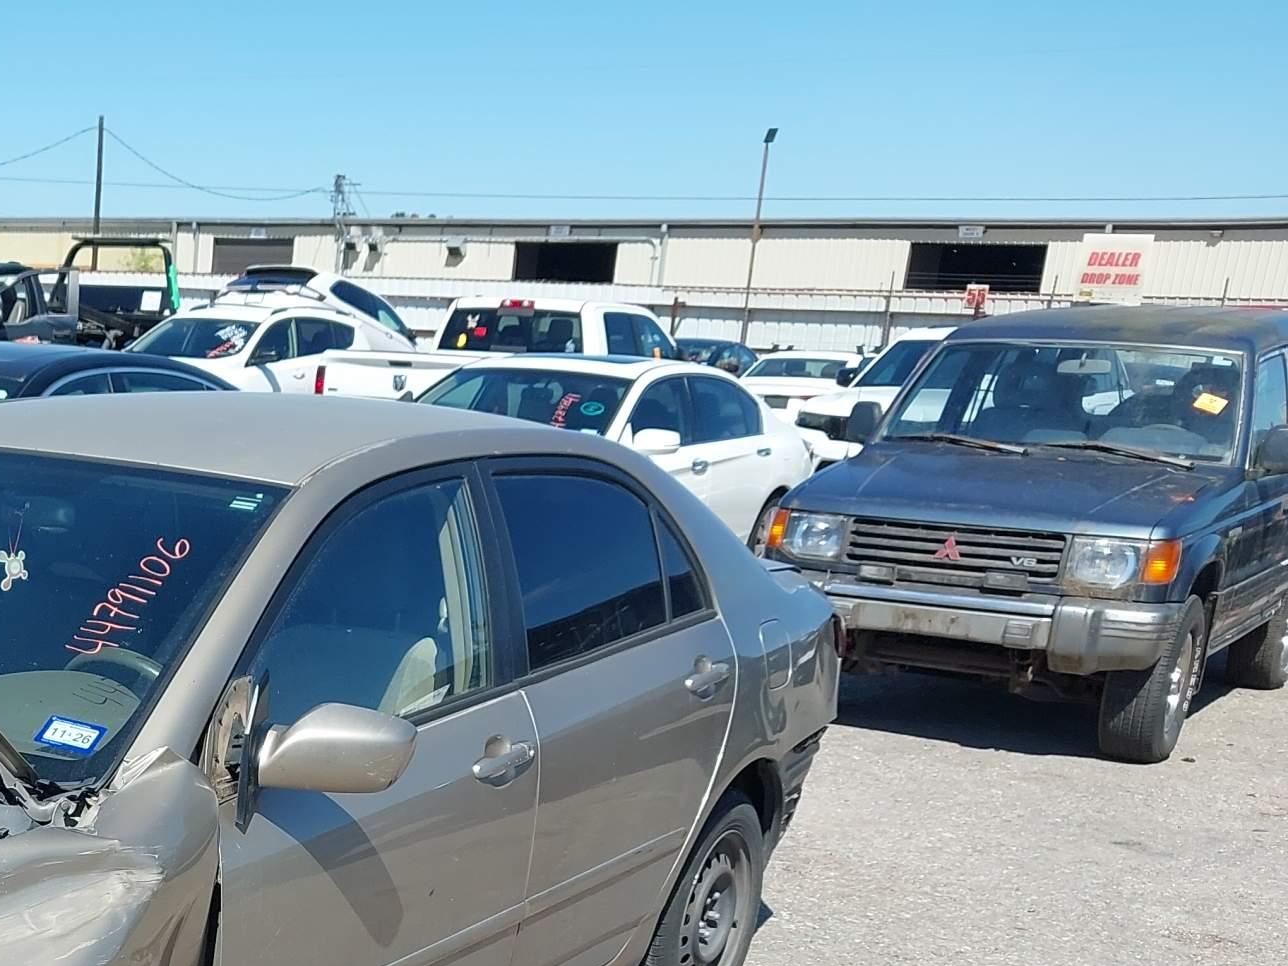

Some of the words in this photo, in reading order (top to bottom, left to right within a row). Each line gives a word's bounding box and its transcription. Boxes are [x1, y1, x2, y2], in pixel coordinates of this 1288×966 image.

[1087, 251, 1142, 268] DEALER
[1080, 272, 1111, 285] DROP
[1112, 273, 1141, 286] ZONE
[966, 288, 987, 307] 55
[1011, 556, 1037, 567] V6
[64, 537, 190, 655] 44791106
